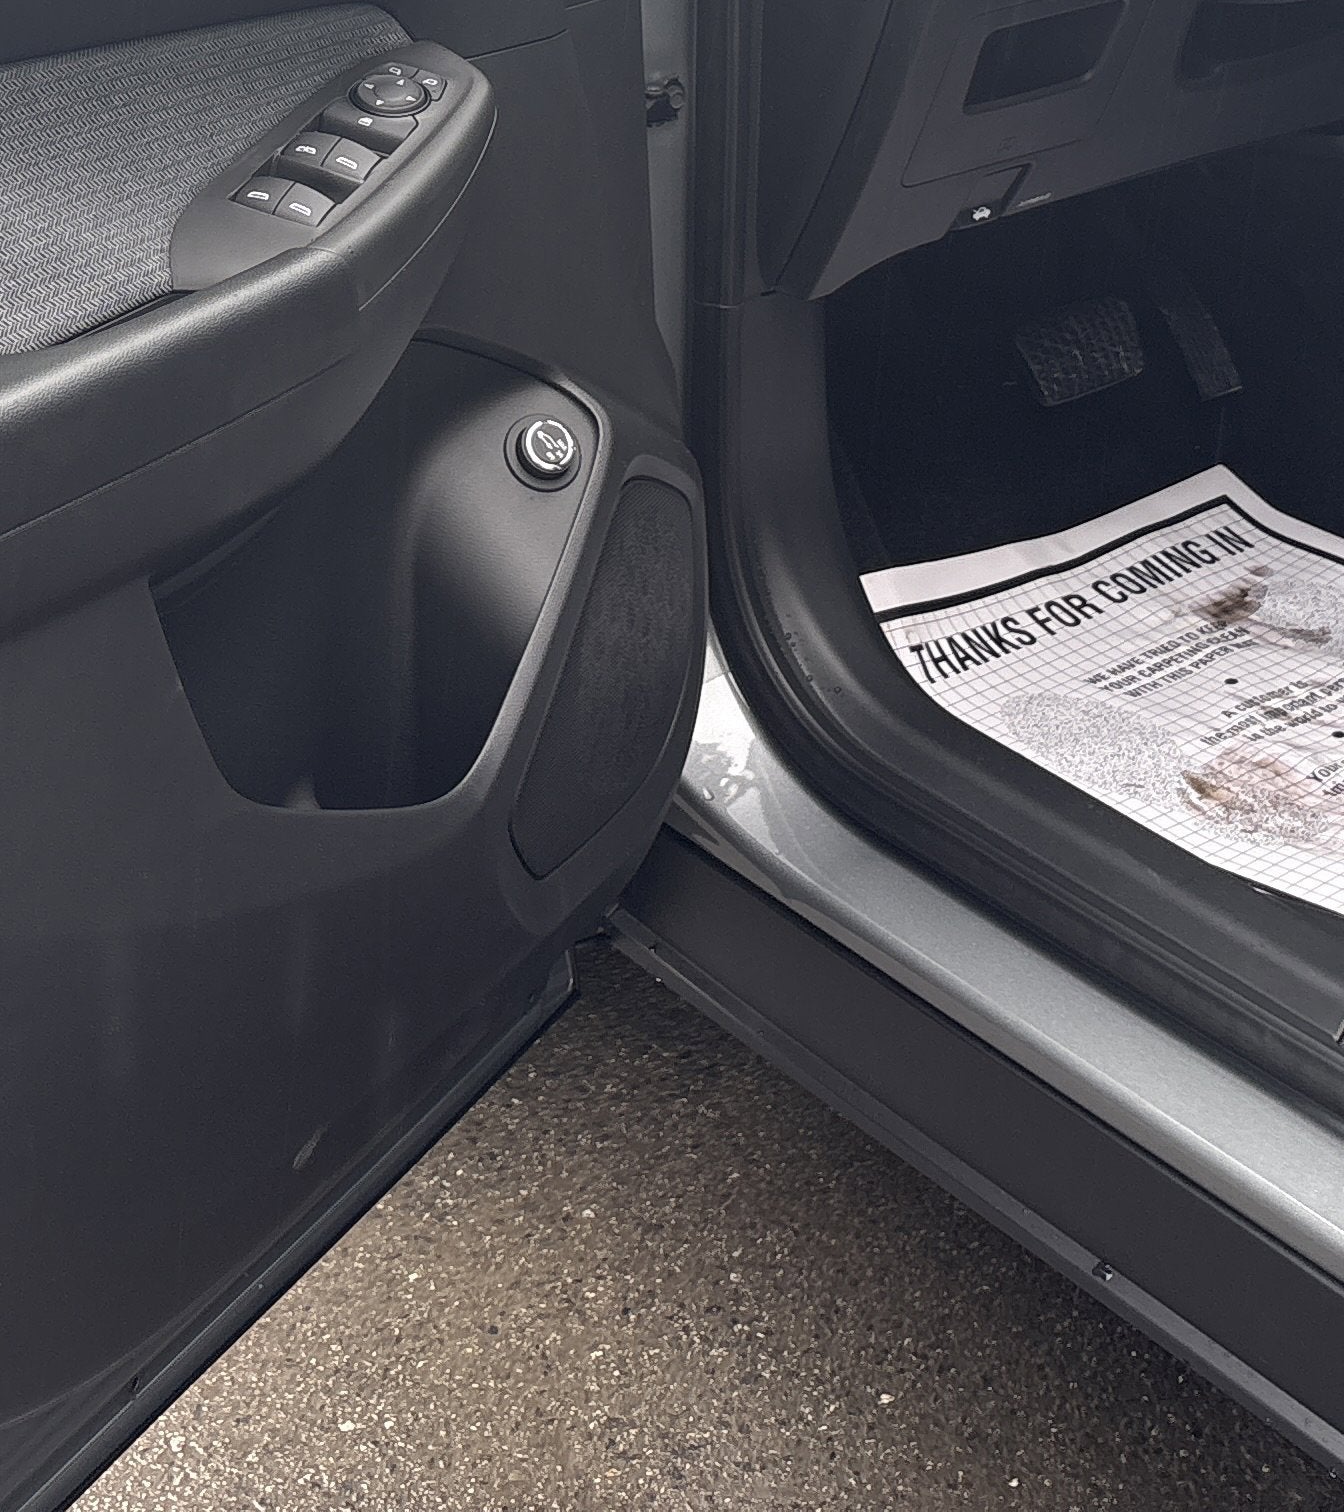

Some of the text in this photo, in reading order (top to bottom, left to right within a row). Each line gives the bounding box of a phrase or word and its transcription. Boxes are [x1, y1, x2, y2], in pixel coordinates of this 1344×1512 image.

[909, 525, 1256, 684] THANKS FOR COMING IN
[1083, 672, 1112, 686] WE
[1106, 657, 1145, 677] HAVE
[1141, 640, 1182, 662] TRIED
[1176, 631, 1201, 644] TO
[1099, 674, 1142, 693] YOUR
[1137, 641, 1210, 679] CARPETING
[1123, 678, 1165, 699] WITH
[1161, 665, 1194, 684] THIS
[1188, 644, 1235, 670] PAPER
[1221, 709, 1237, 719] A
[1234, 685, 1294, 712] customer
[1305, 761, 1342, 783] Your
